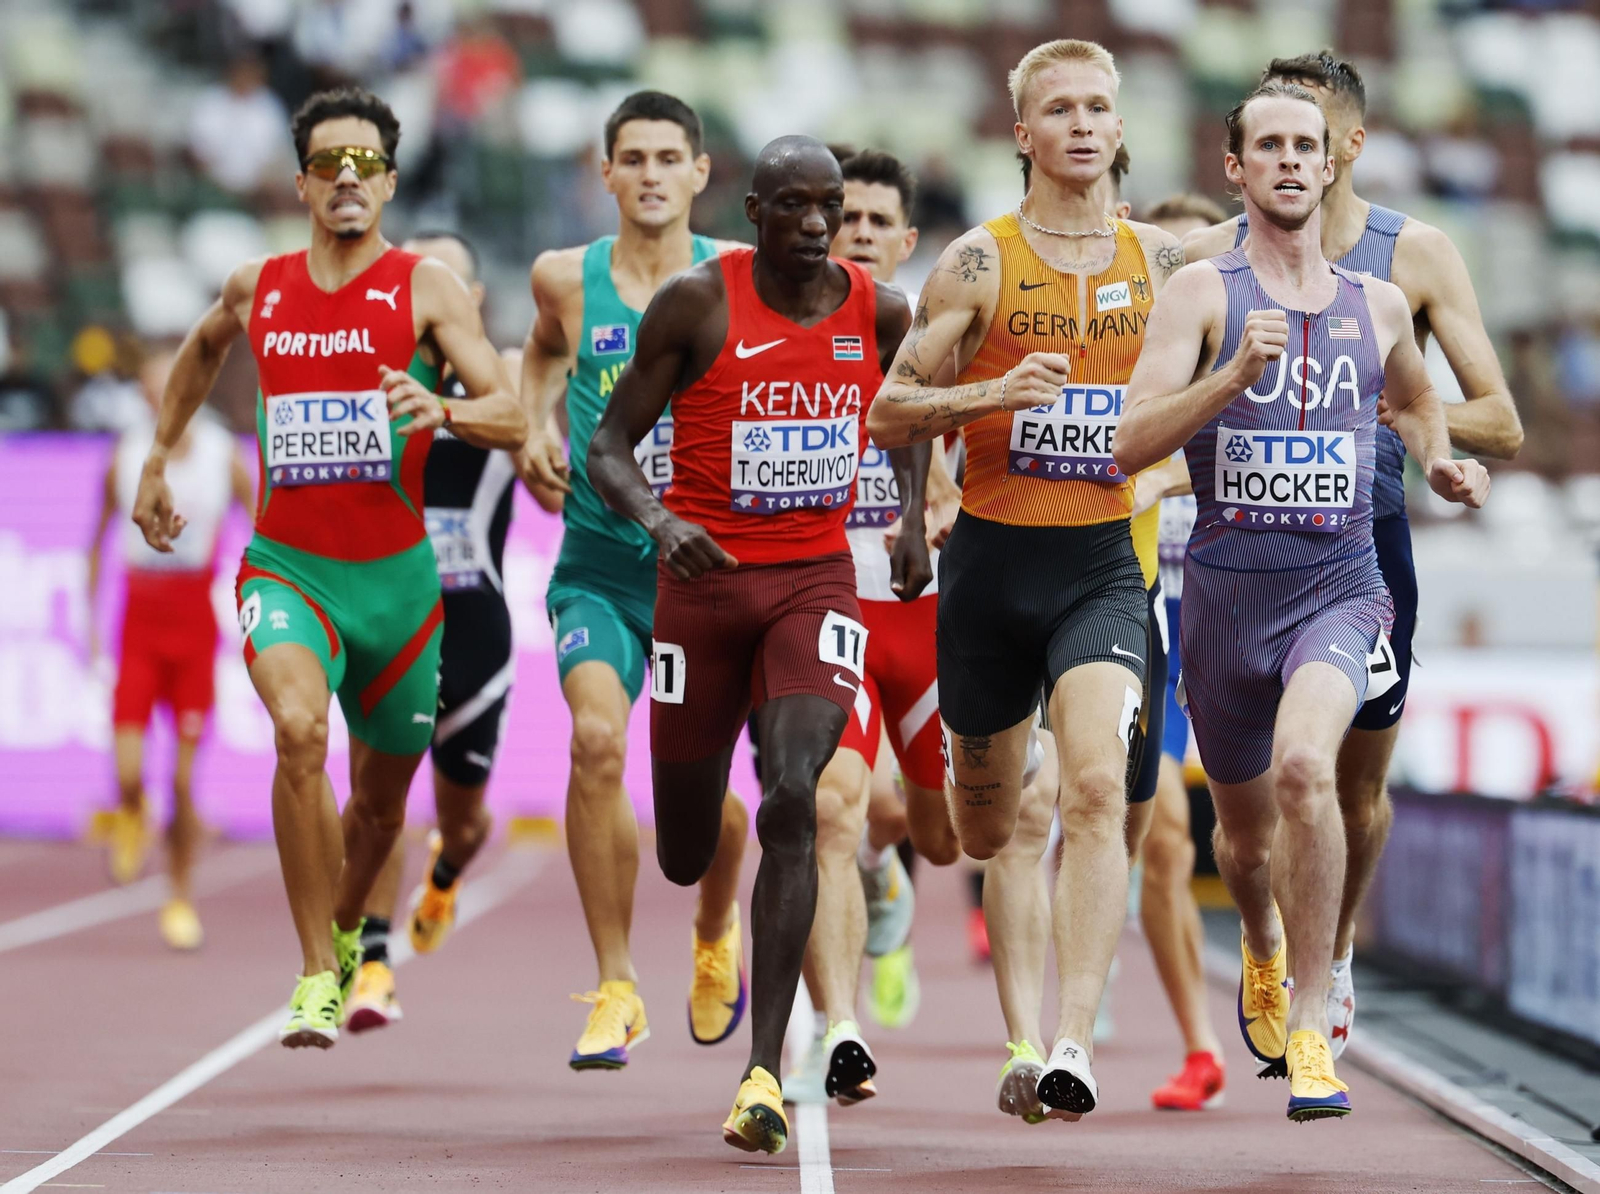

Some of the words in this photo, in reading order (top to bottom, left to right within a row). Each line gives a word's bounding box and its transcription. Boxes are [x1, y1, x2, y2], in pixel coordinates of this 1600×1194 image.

[1097, 288, 1128, 305] WGV
[1008, 310, 1149, 342] GERMANY
[263, 328, 376, 358] PORTUGAL
[1243, 350, 1360, 411] USA
[295, 397, 377, 424] TDK
[740, 381, 861, 417] KENYA
[272, 430, 383, 460] PEREIRA
[771, 421, 850, 453] TDK
[1252, 436, 1346, 465] TDK
[737, 460, 752, 486] T.
[757, 452, 855, 488] CHERUIYOT
[1223, 470, 1349, 502] HOCKER
[831, 623, 861, 666] 11
